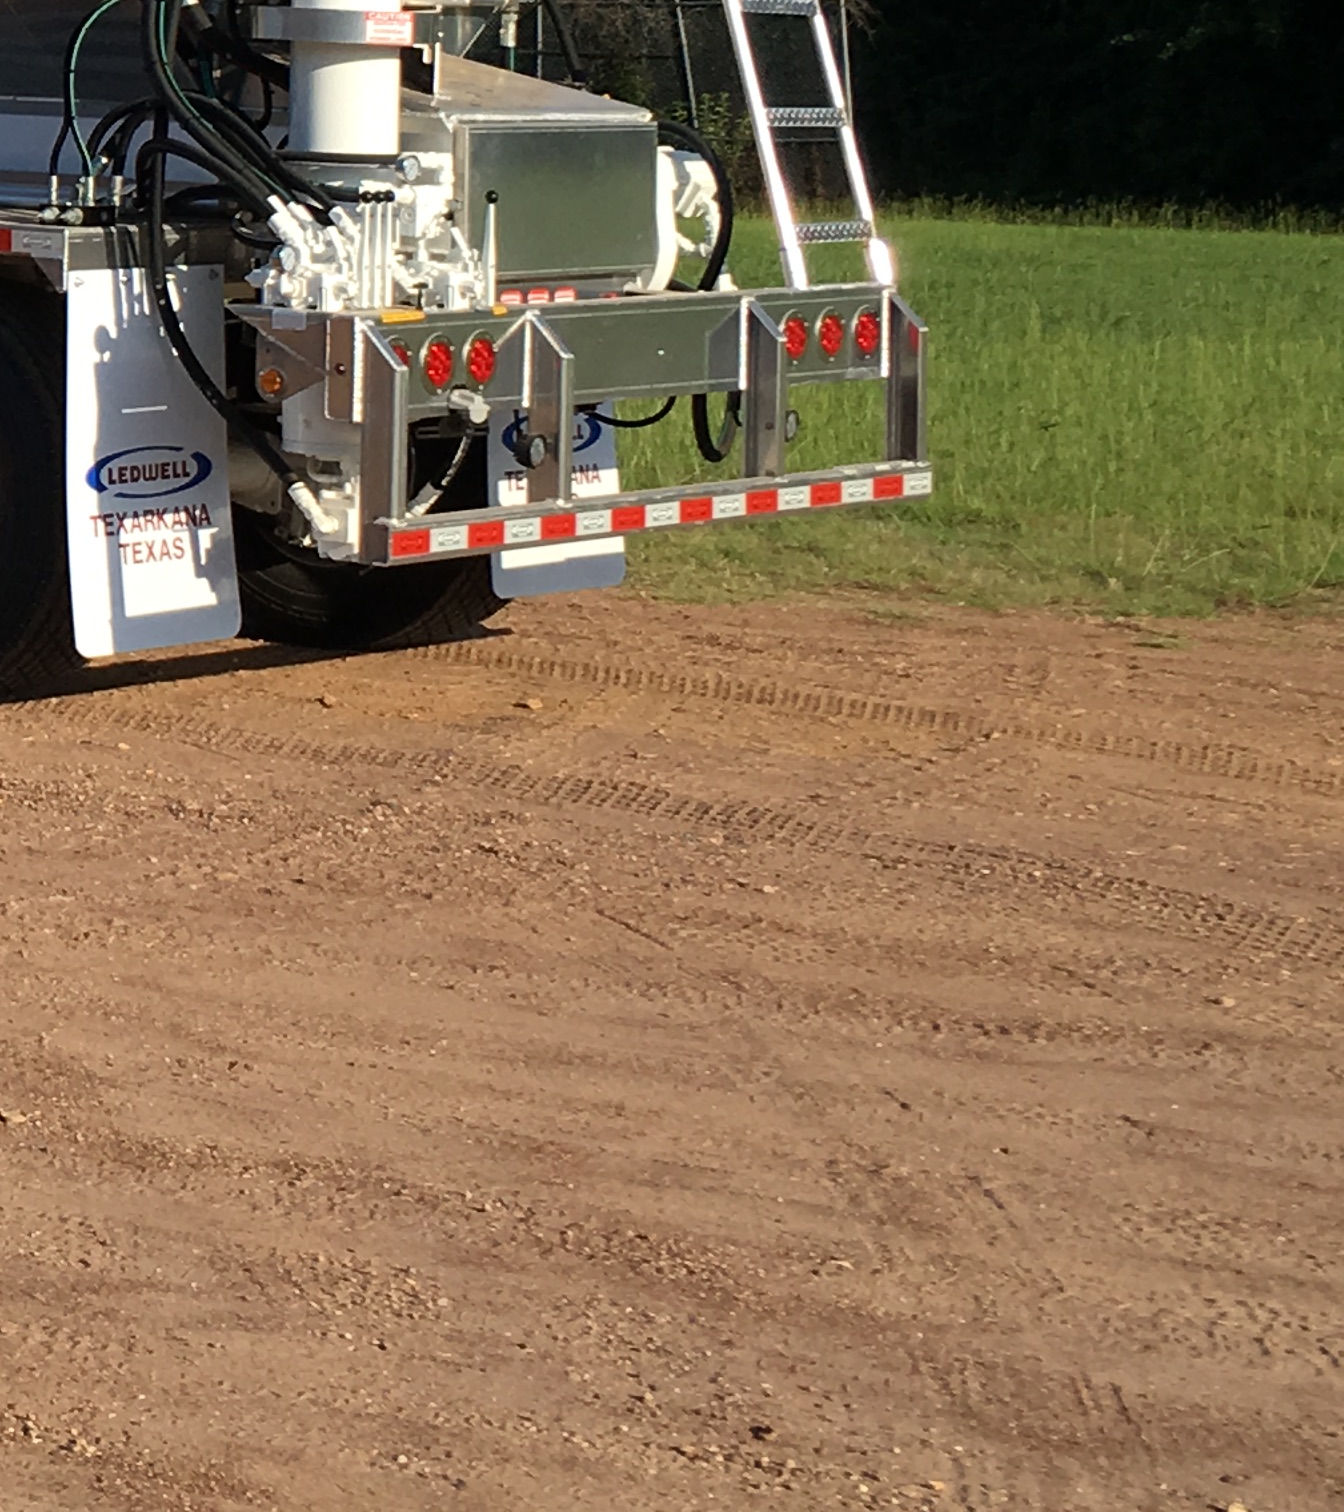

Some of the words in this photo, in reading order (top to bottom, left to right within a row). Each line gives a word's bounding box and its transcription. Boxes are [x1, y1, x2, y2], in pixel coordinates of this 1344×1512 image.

[107, 460, 191, 485] LEDWELL
[89, 503, 212, 537] TEXARKANA
[118, 536, 186, 565] TEXAS
